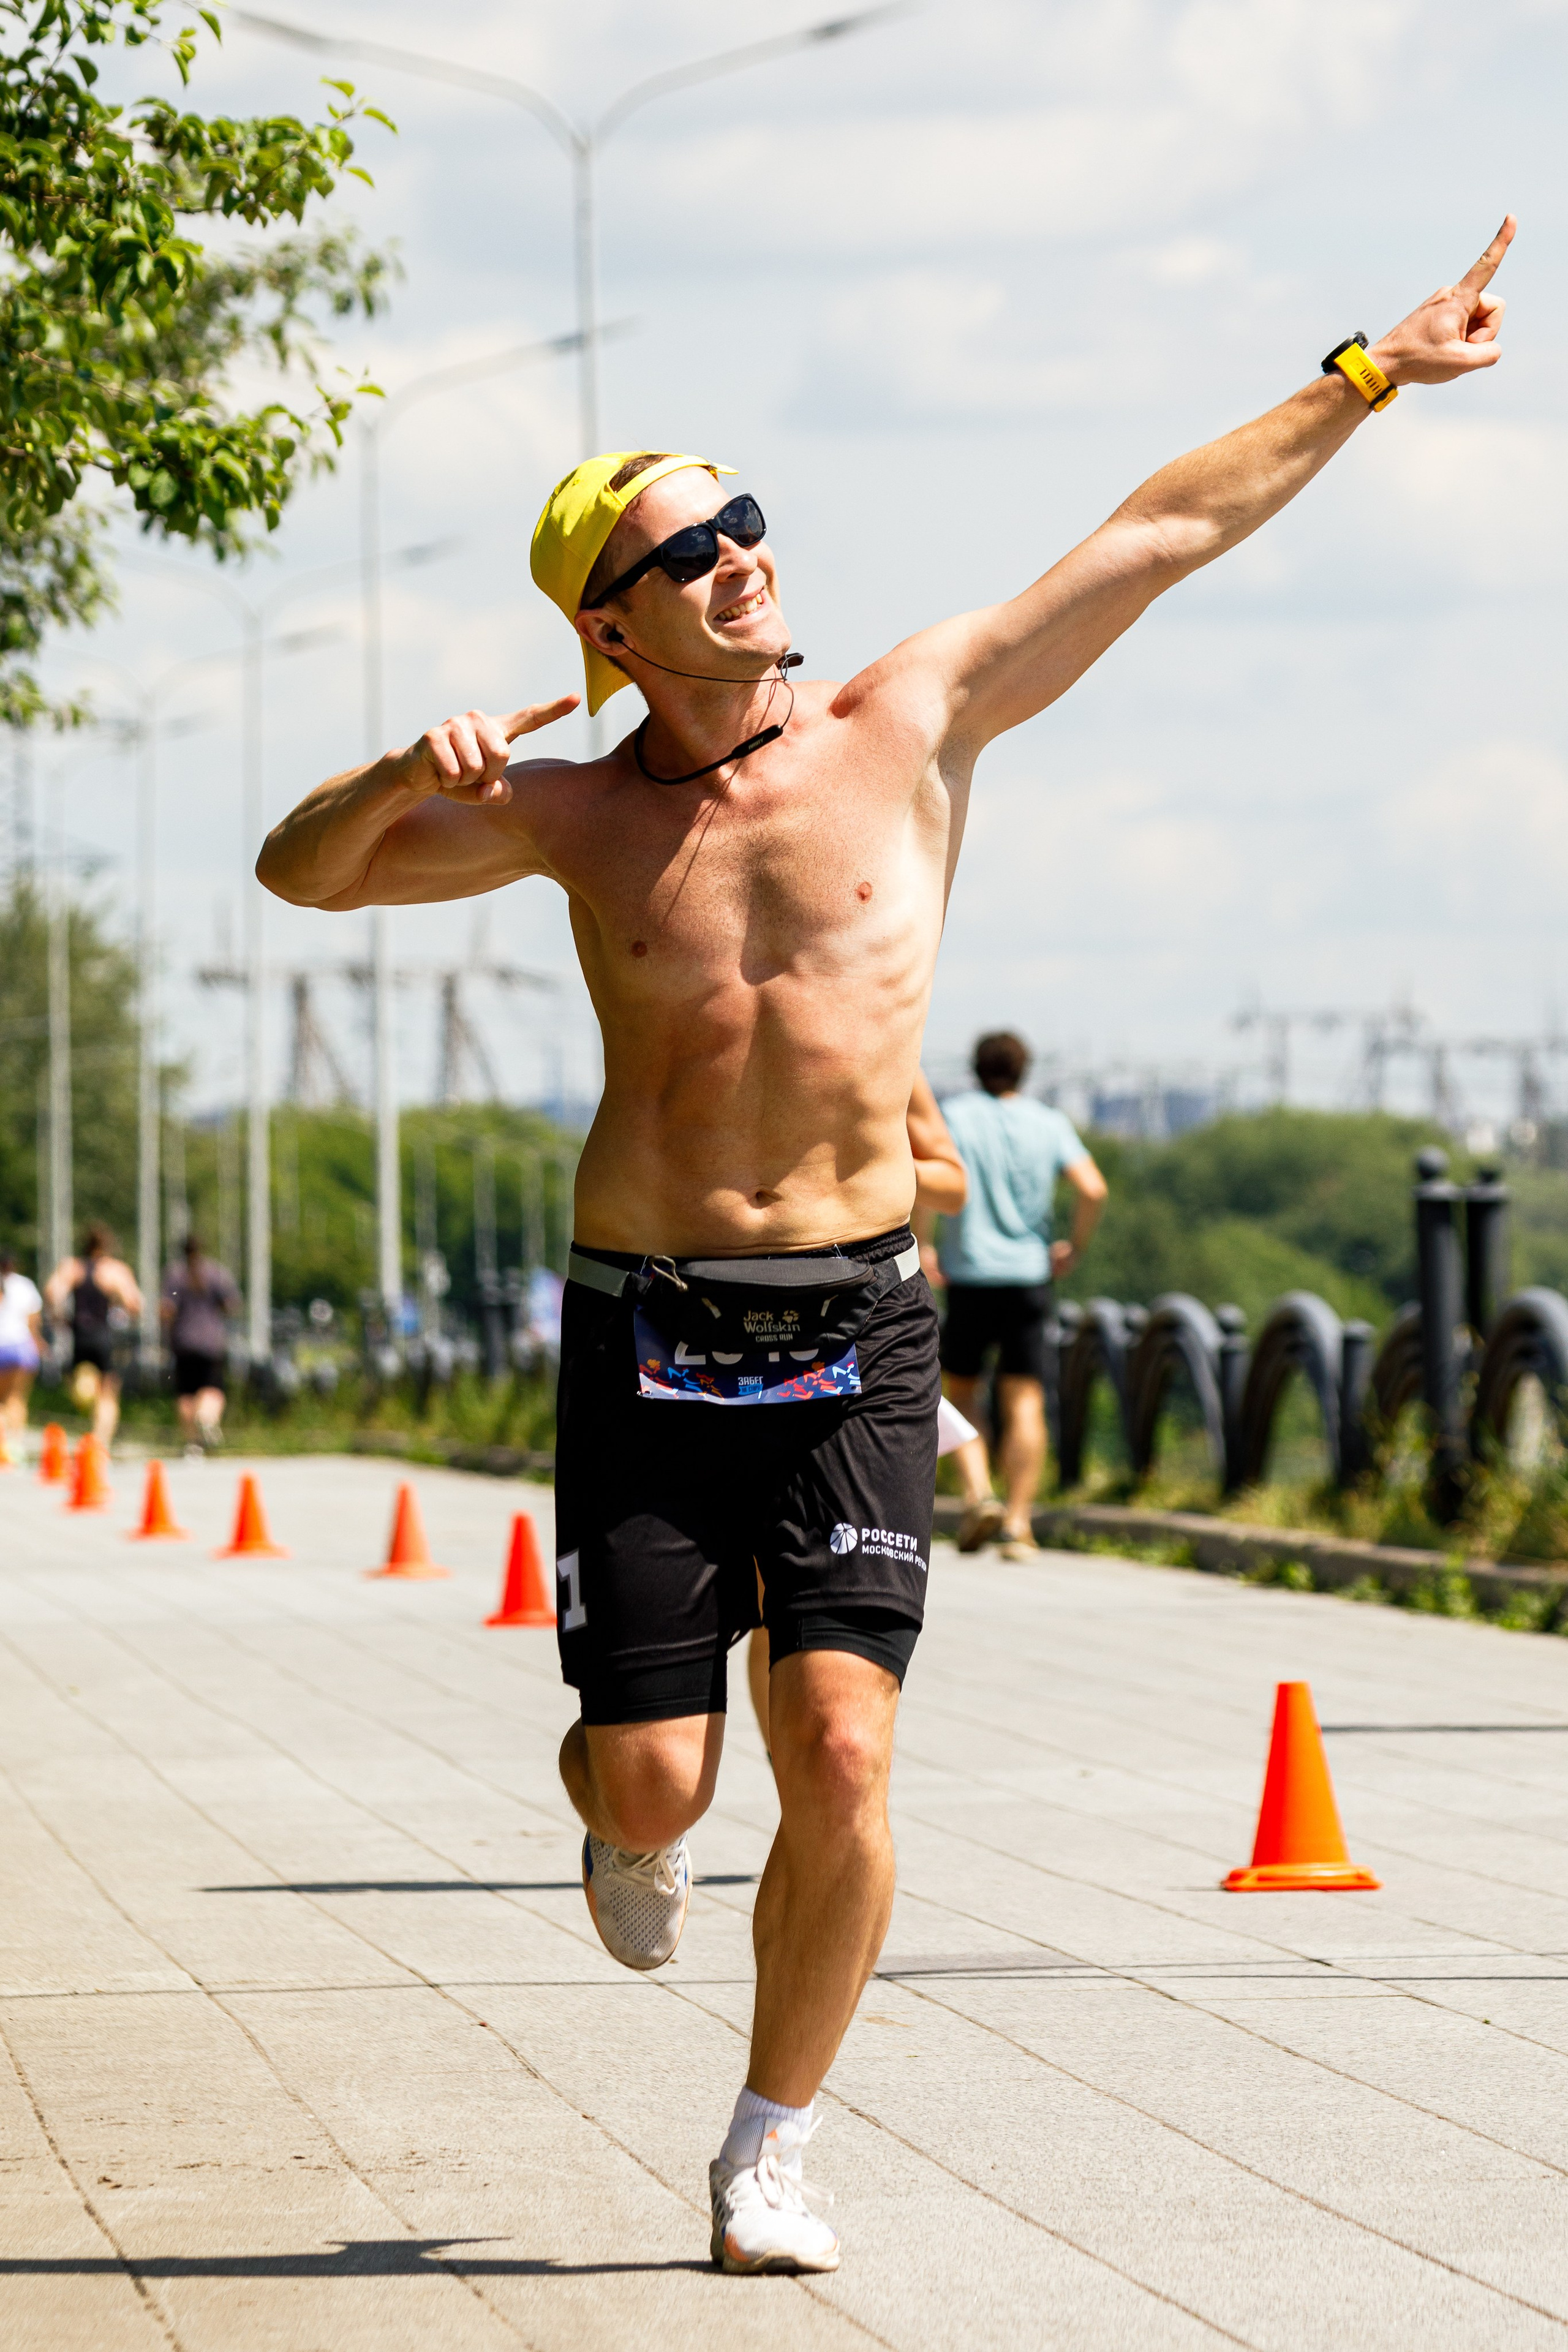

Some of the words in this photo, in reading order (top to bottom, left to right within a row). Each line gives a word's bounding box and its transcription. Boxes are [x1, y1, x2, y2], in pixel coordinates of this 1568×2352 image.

[743, 1310, 774, 1322] Jack
[743, 1321, 801, 1333] Wolfskin
[755, 1334, 778, 1343] CROSS
[779, 1333, 793, 1341] RUN
[861, 1528, 918, 1551] РОССЕТИ
[862, 1544, 914, 1563] МОСКОВСКИЙ
[557, 1548, 588, 1633] 1
